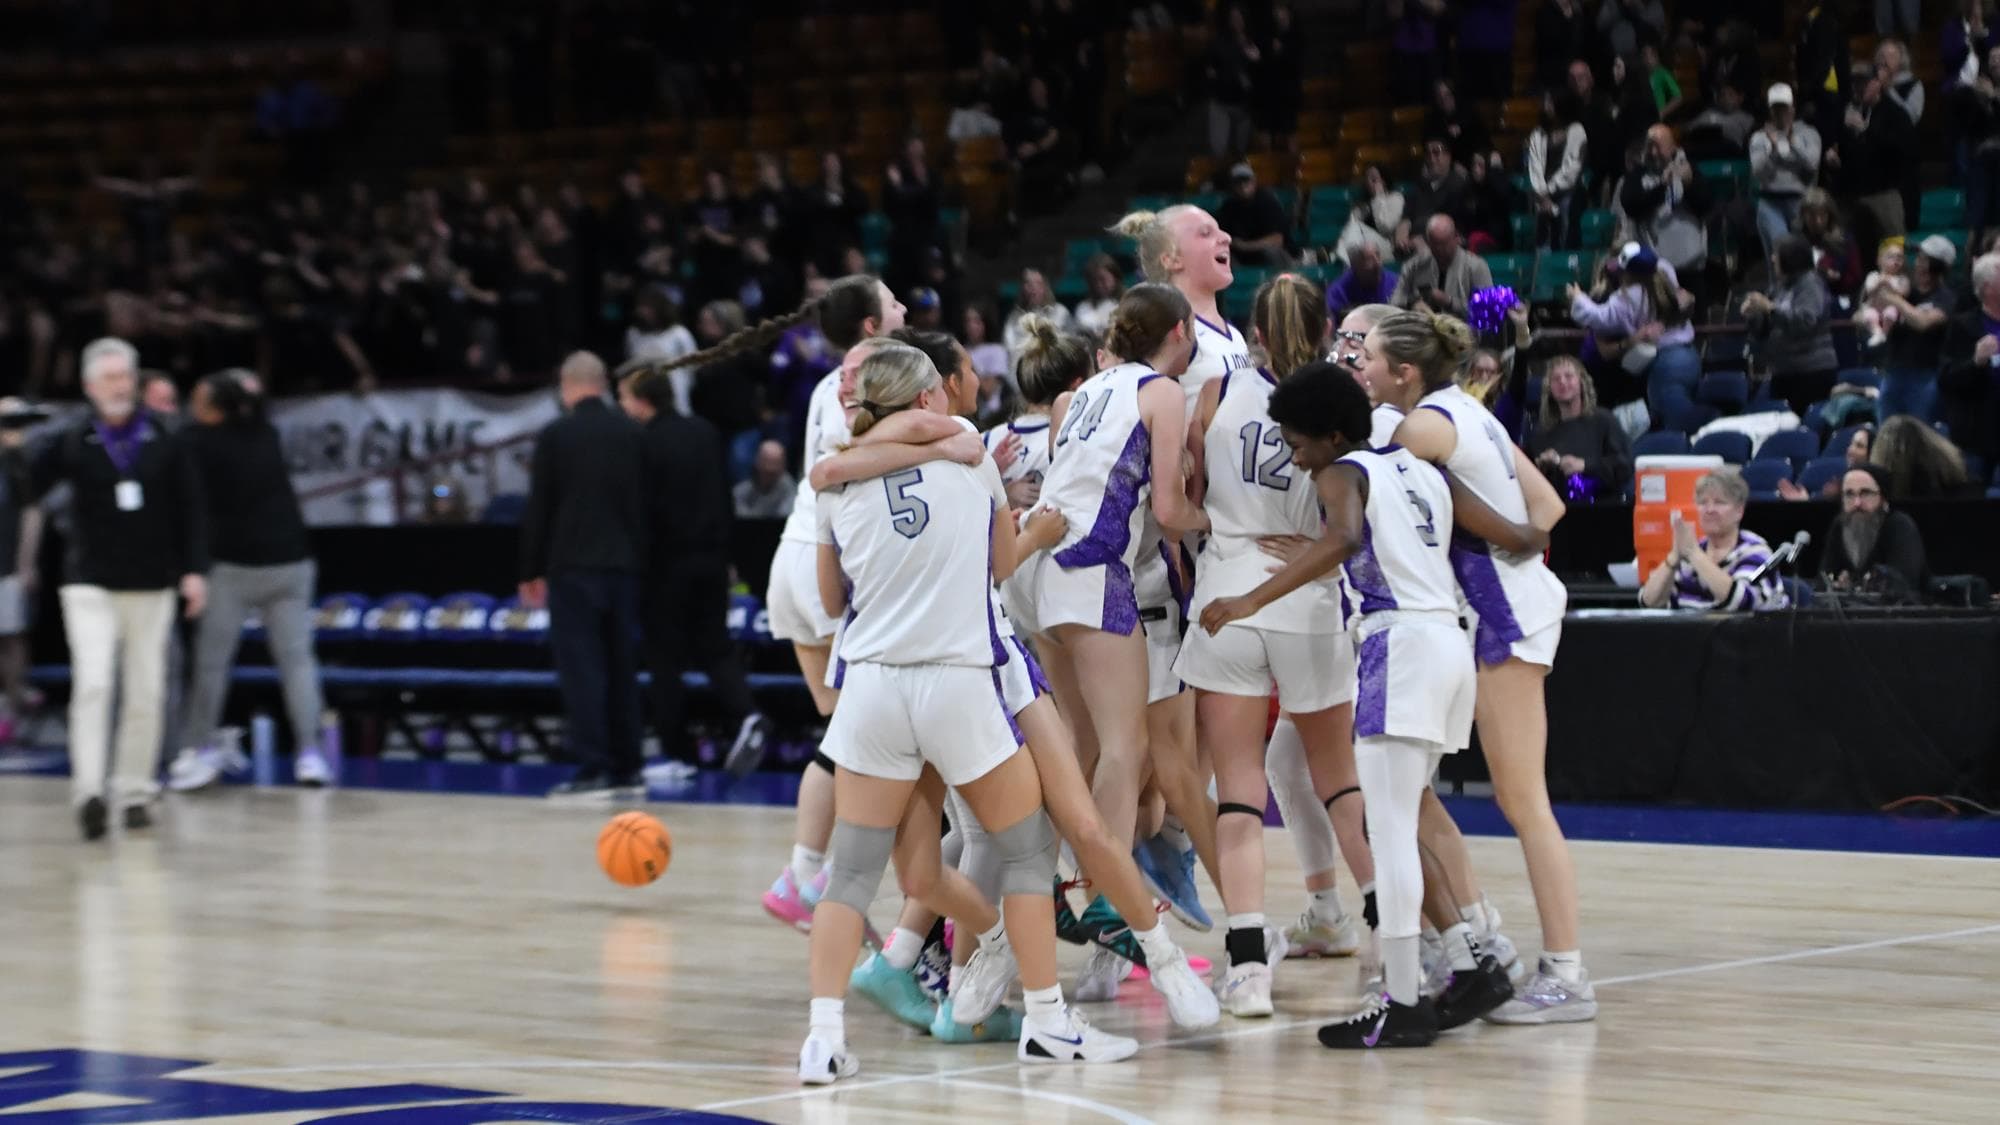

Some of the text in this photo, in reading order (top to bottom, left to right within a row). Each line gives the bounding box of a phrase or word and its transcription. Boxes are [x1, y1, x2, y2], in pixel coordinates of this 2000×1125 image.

[1056, 388, 1113, 447] 24
[1240, 420, 1294, 491] 12
[883, 467, 930, 539] 5
